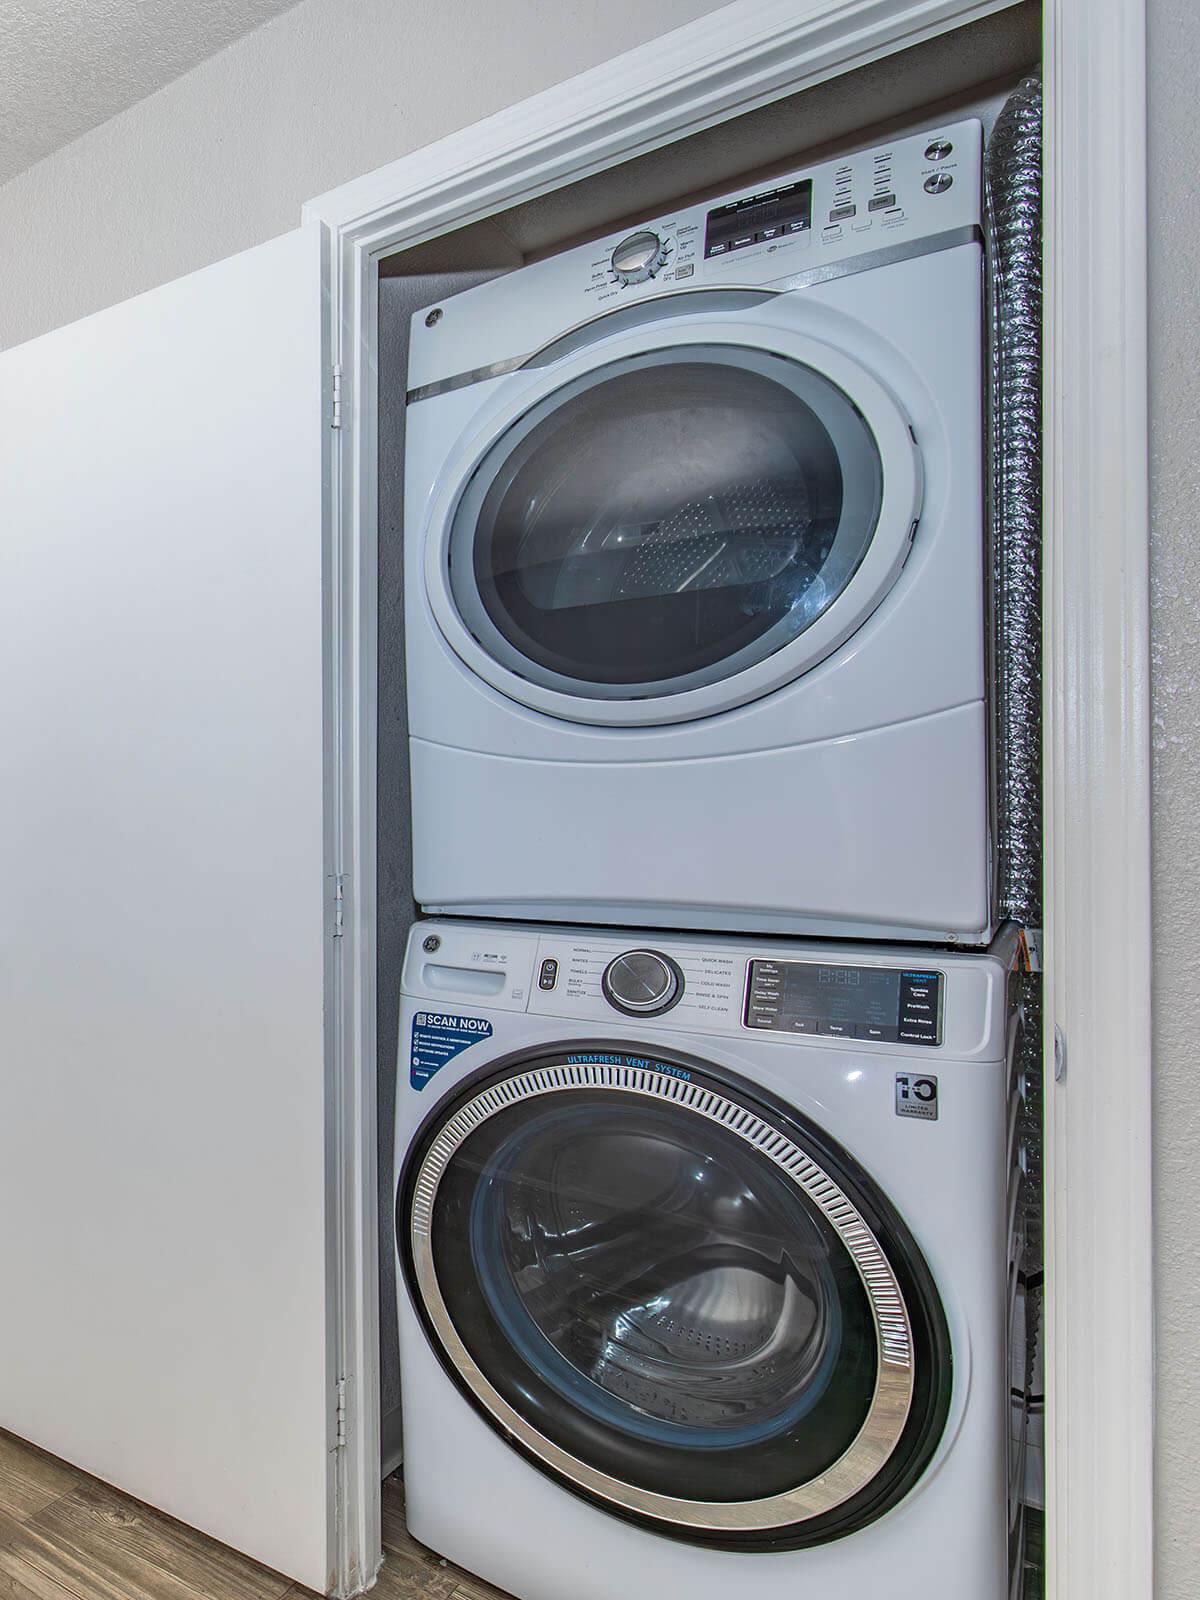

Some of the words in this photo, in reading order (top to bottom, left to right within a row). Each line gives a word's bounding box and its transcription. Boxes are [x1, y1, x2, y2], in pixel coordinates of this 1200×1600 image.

[427, 1014, 457, 1027] SCAN
[460, 1018, 489, 1031] NOW
[567, 1055, 622, 1064] ULTRAFRESH
[626, 1058, 650, 1068] VENT
[654, 1064, 692, 1081] SYSTEM
[896, 1078, 936, 1101] 10
